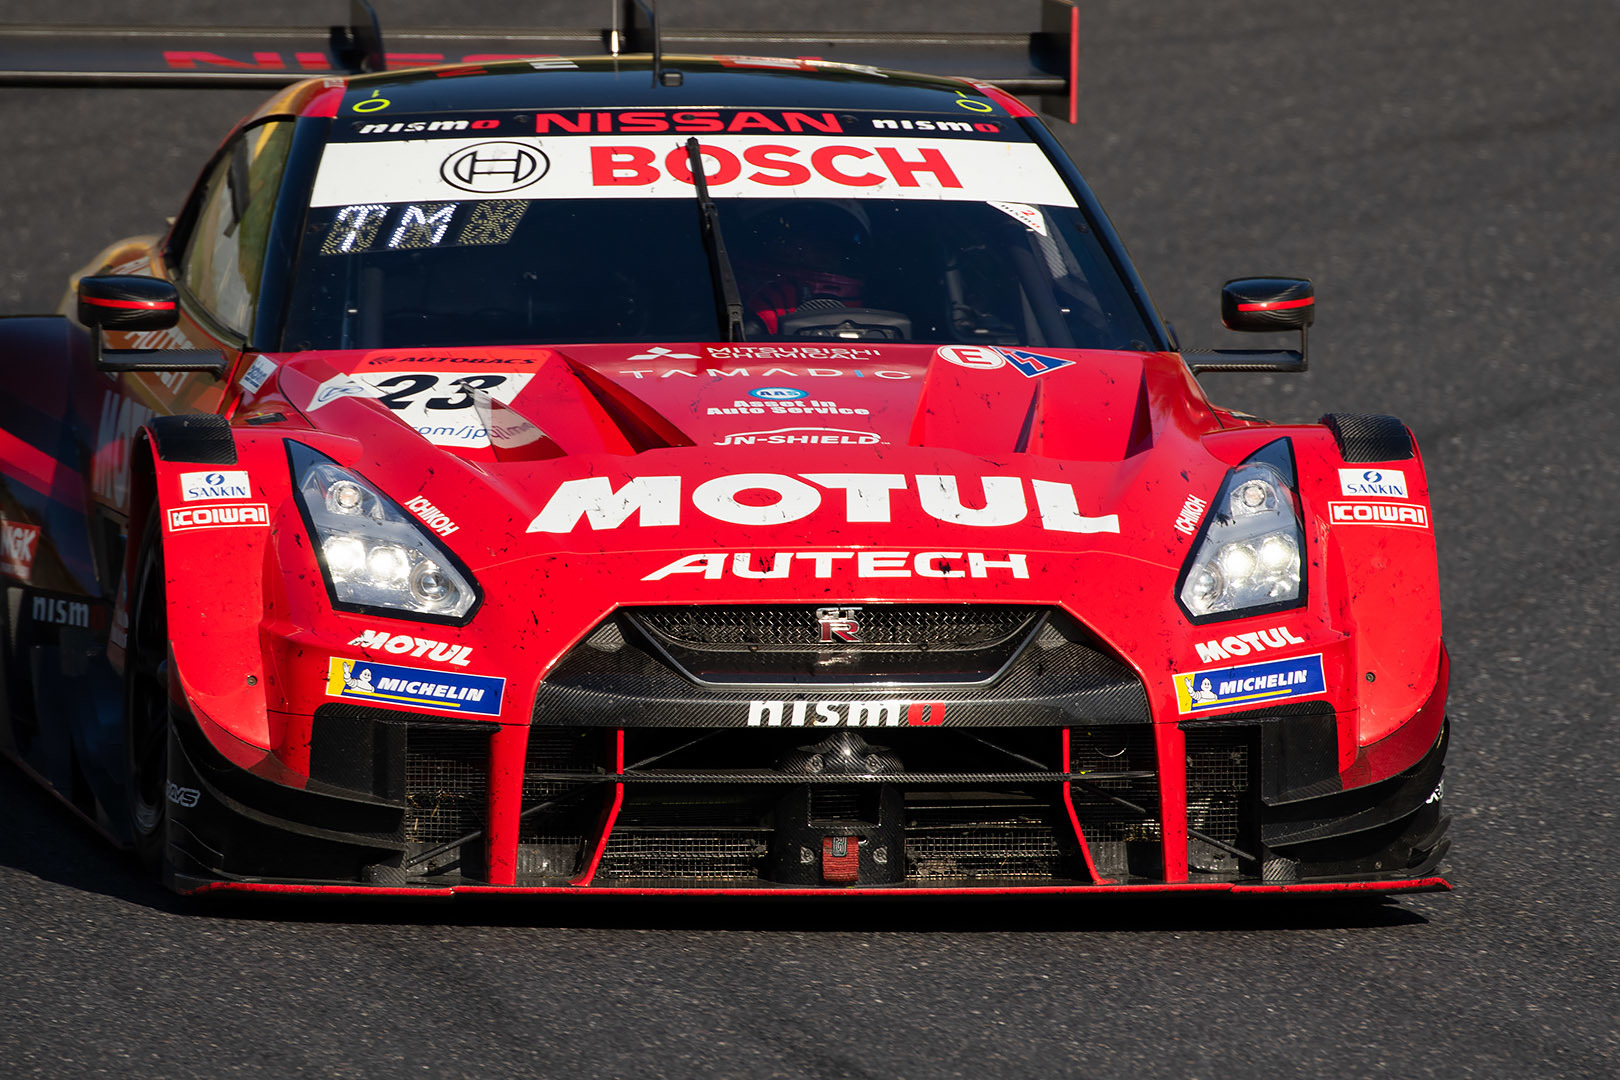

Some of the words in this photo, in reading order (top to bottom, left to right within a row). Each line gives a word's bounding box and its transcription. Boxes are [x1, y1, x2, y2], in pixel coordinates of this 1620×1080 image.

[359, 119, 500, 134] nismo
[536, 112, 844, 134] NISSAN
[872, 119, 1000, 133] nismo
[590, 144, 963, 189] BOSCH
[397, 357, 537, 365] AUTOBACS
[707, 347, 880, 356] MITSUBISHI
[711, 352, 869, 360] CHEMICAL
[619, 368, 911, 379] TAMADIC
[375, 374, 508, 410] 23
[760, 390, 801, 398] AAS
[707, 406, 765, 415] Auto
[771, 406, 870, 416] Service
[733, 400, 805, 408] Asset
[810, 400, 836, 408] In
[188, 486, 247, 499] SANKIN
[1347, 483, 1403, 496] SANKIN
[527, 472, 1119, 534] MOTUL
[173, 507, 266, 526] KOIWAI
[404, 495, 459, 537] ICHIKOH
[1174, 494, 1207, 535] ICHIKOH
[1334, 505, 1425, 524] KOIWAI
[641, 551, 1029, 581] AUTECH
[347, 629, 473, 667] MOTUL
[1195, 626, 1305, 663] MOTUL
[377, 677, 485, 701] MICHELIN
[1219, 669, 1307, 695] MICHELIN
[747, 700, 946, 726] nismo
